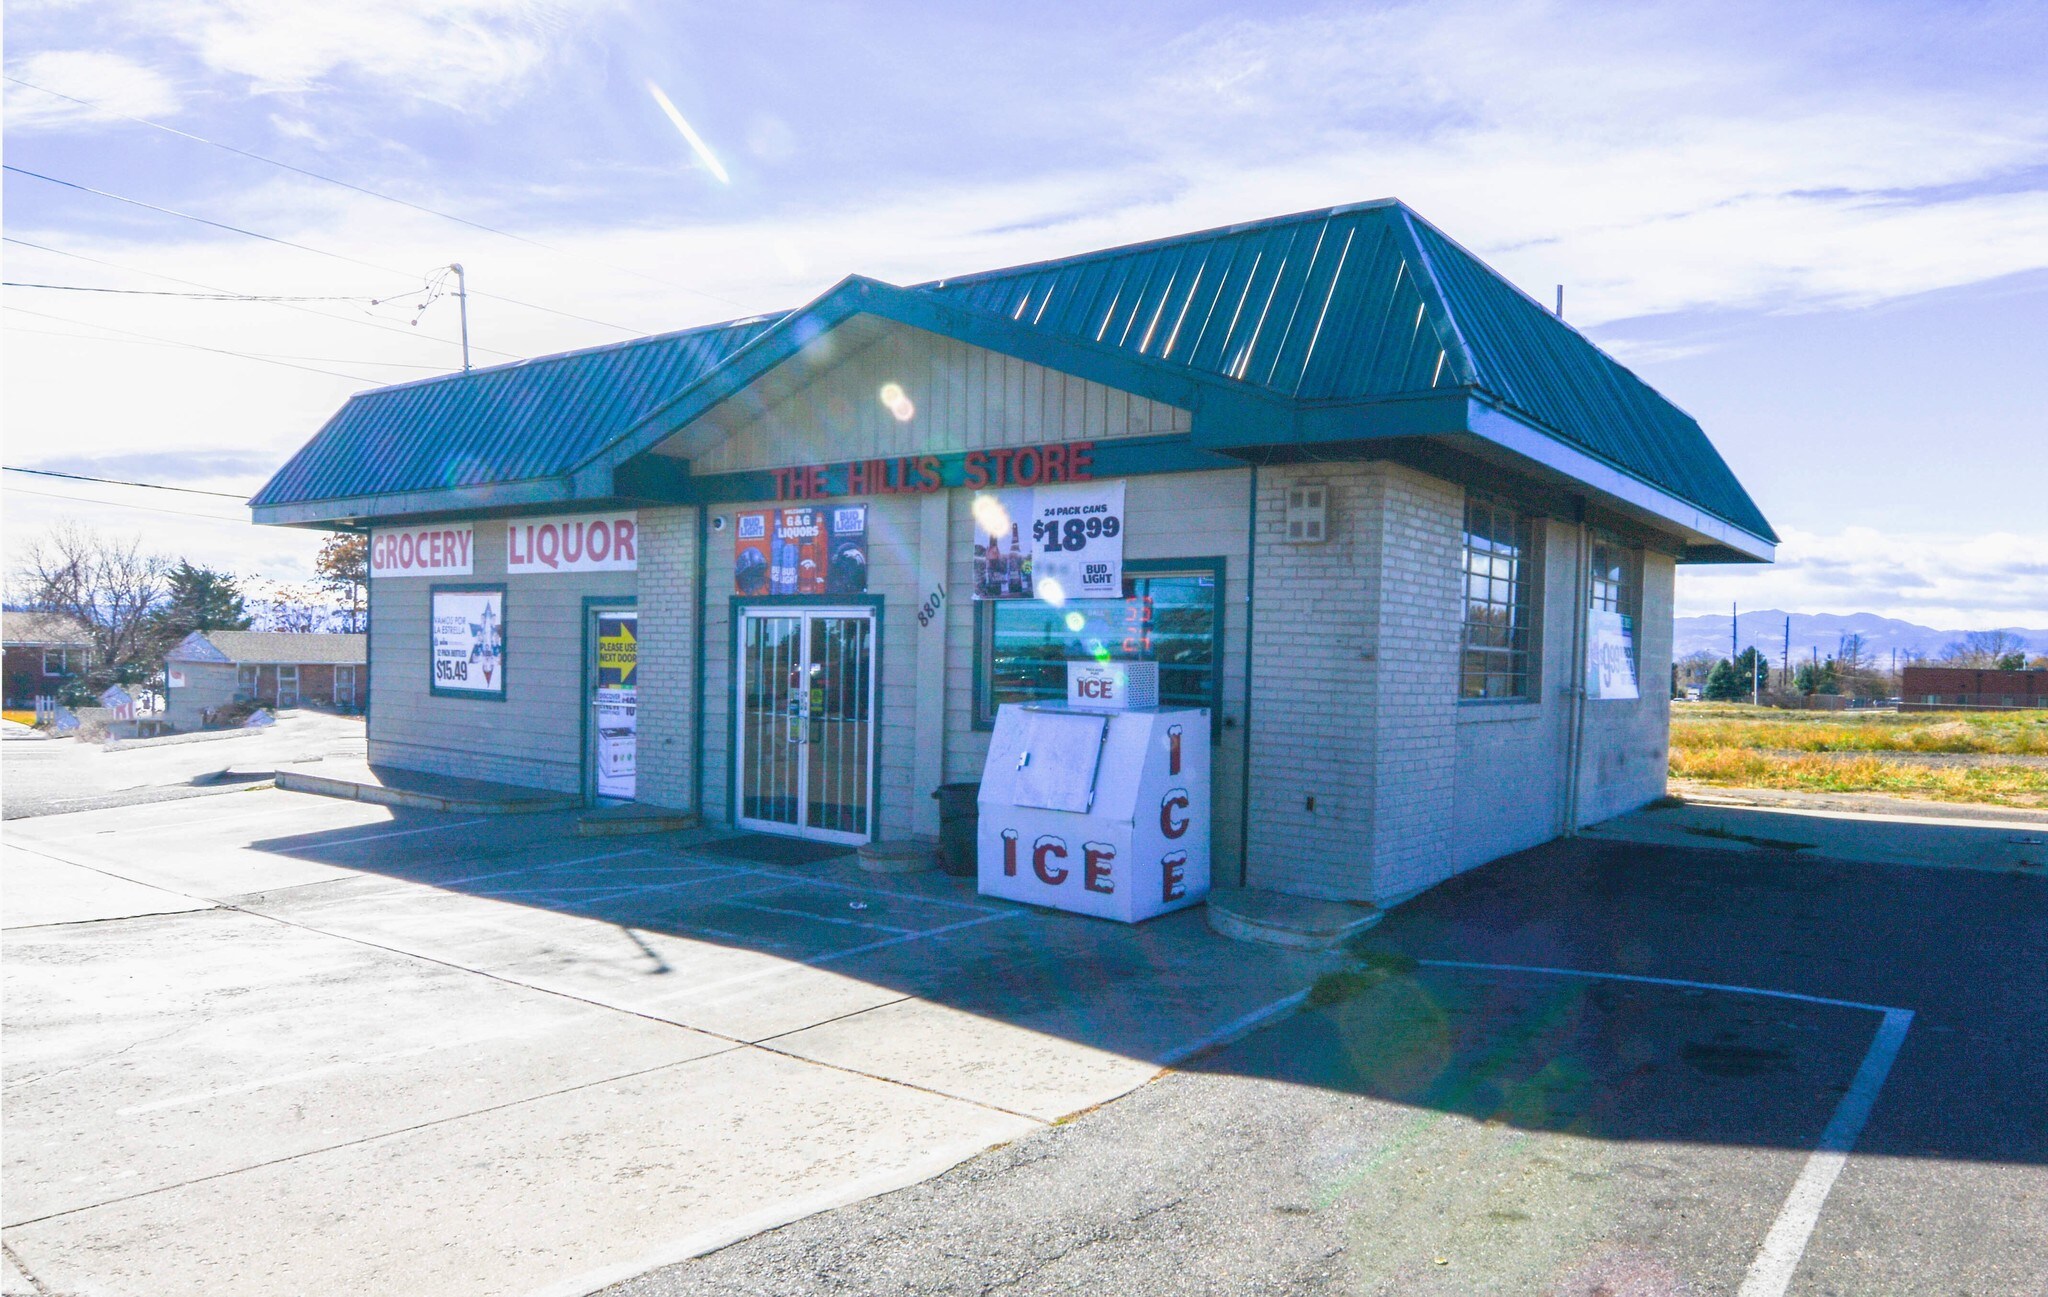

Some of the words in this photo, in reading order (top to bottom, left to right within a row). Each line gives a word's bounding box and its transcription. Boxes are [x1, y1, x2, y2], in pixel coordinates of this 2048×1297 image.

[771, 465, 829, 500] THE
[850, 454, 942, 495] HILL'S
[964, 441, 1094, 489] STORE
[840, 510, 859, 520] BUD
[1044, 508, 1055, 516] 24
[1057, 506, 1080, 515] PACK
[1083, 504, 1107, 513] CANS
[743, 517, 760, 526] BUD
[787, 516, 793, 526] G
[803, 515, 810, 525] G
[836, 519, 862, 531] LIGHT
[741, 525, 764, 536] LIGHT
[778, 526, 819, 539] LIQUORS
[372, 529, 472, 570] GROCERY
[509, 519, 635, 569] LIQUOR
[782, 567, 796, 575] BUD
[1086, 564, 1107, 574] BUD
[1083, 574, 1112, 584] LIGHT
[918, 583, 945, 627] 8801
[455, 616, 466, 624] POR
[442, 626, 465, 634] ESTRELLA
[599, 642, 623, 652] PLEASE
[625, 643, 637, 652] USE
[600, 653, 616, 662] NEXT
[617, 653, 637, 663] DOOR
[436, 659, 467, 681] $15.49
[1077, 677, 1113, 699] ICE
[1160, 723, 1190, 903] ICE
[1001, 828, 1116, 894] ICE
